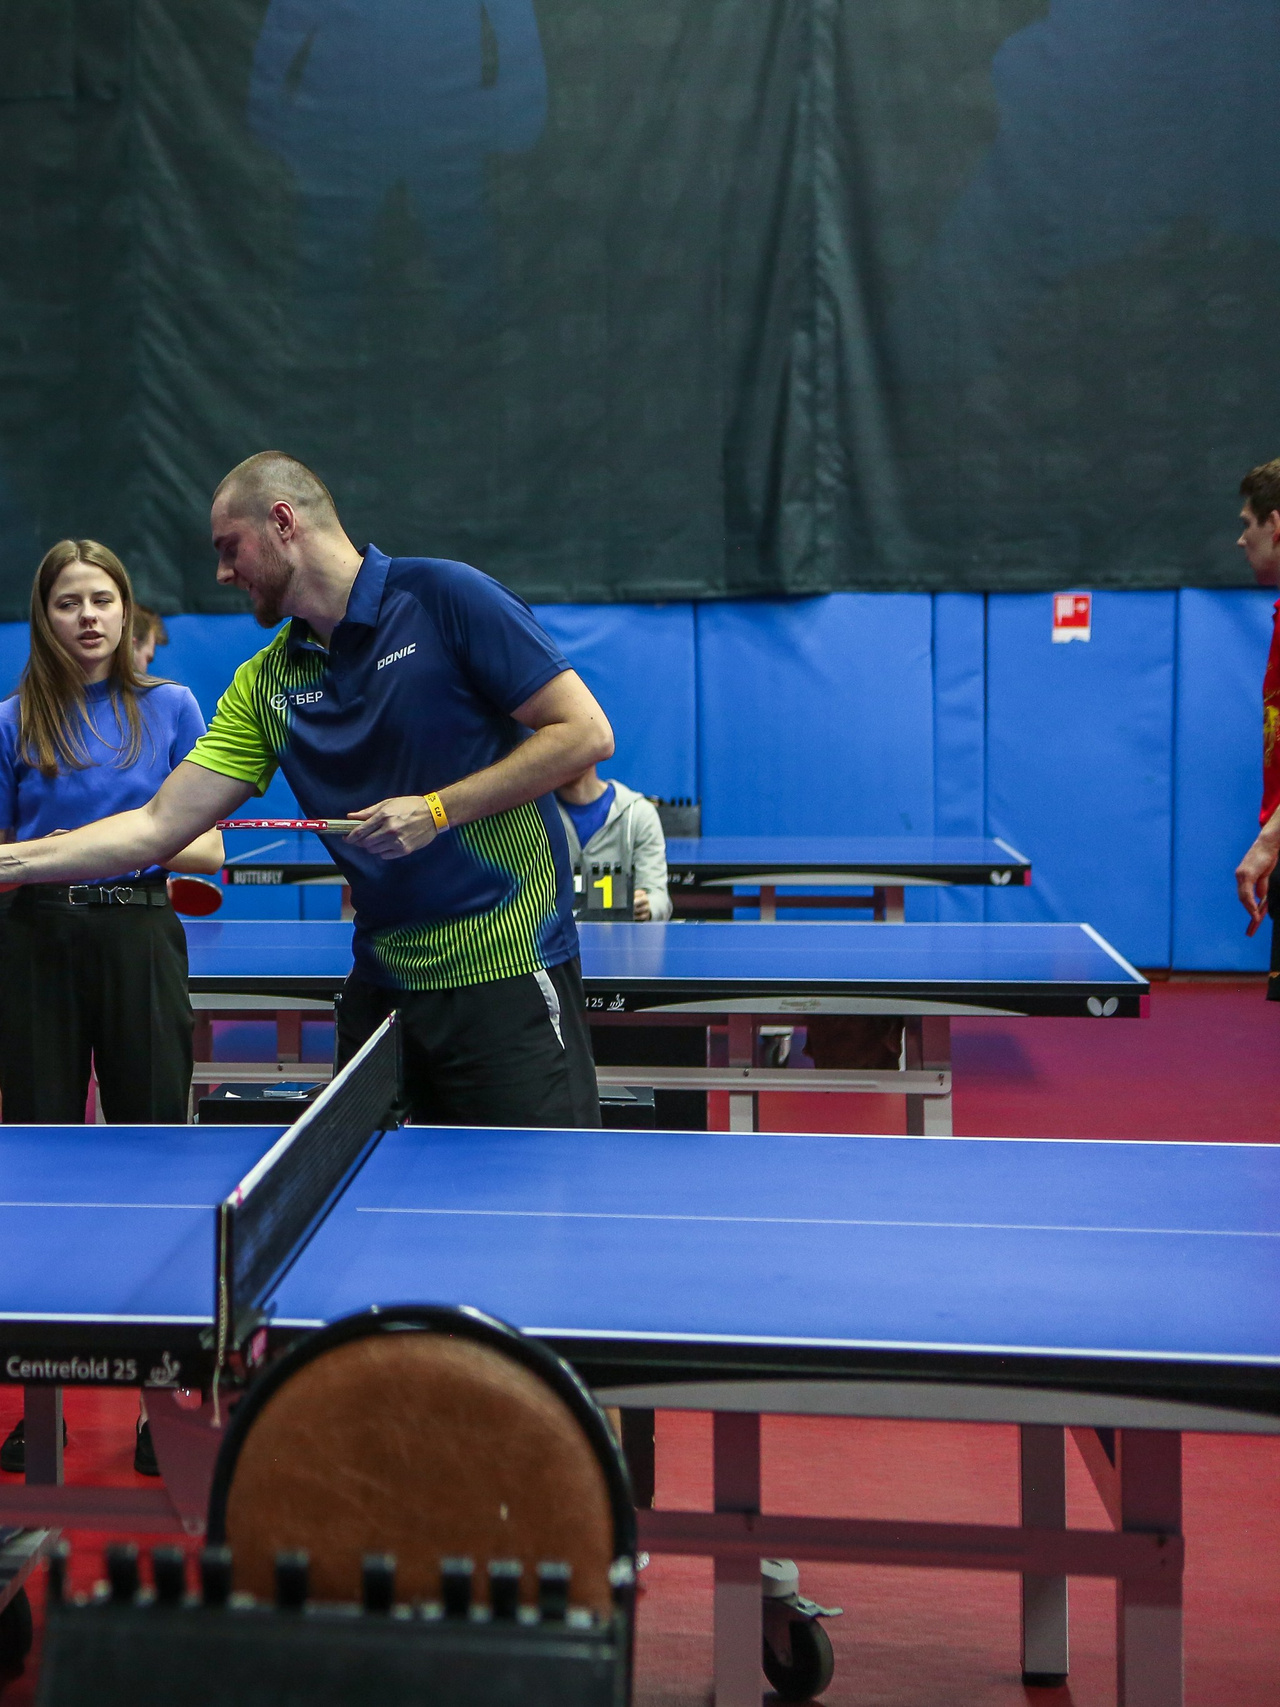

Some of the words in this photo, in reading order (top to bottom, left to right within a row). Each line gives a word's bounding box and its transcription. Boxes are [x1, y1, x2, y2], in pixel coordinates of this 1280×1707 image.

[377, 642, 416, 671] DONIC
[233, 870, 284, 885] BUTTERFLY
[593, 875, 613, 909] 1
[591, 997, 604, 1008] 25
[6, 1355, 109, 1380] Centrefold
[113, 1358, 138, 1380] 25
